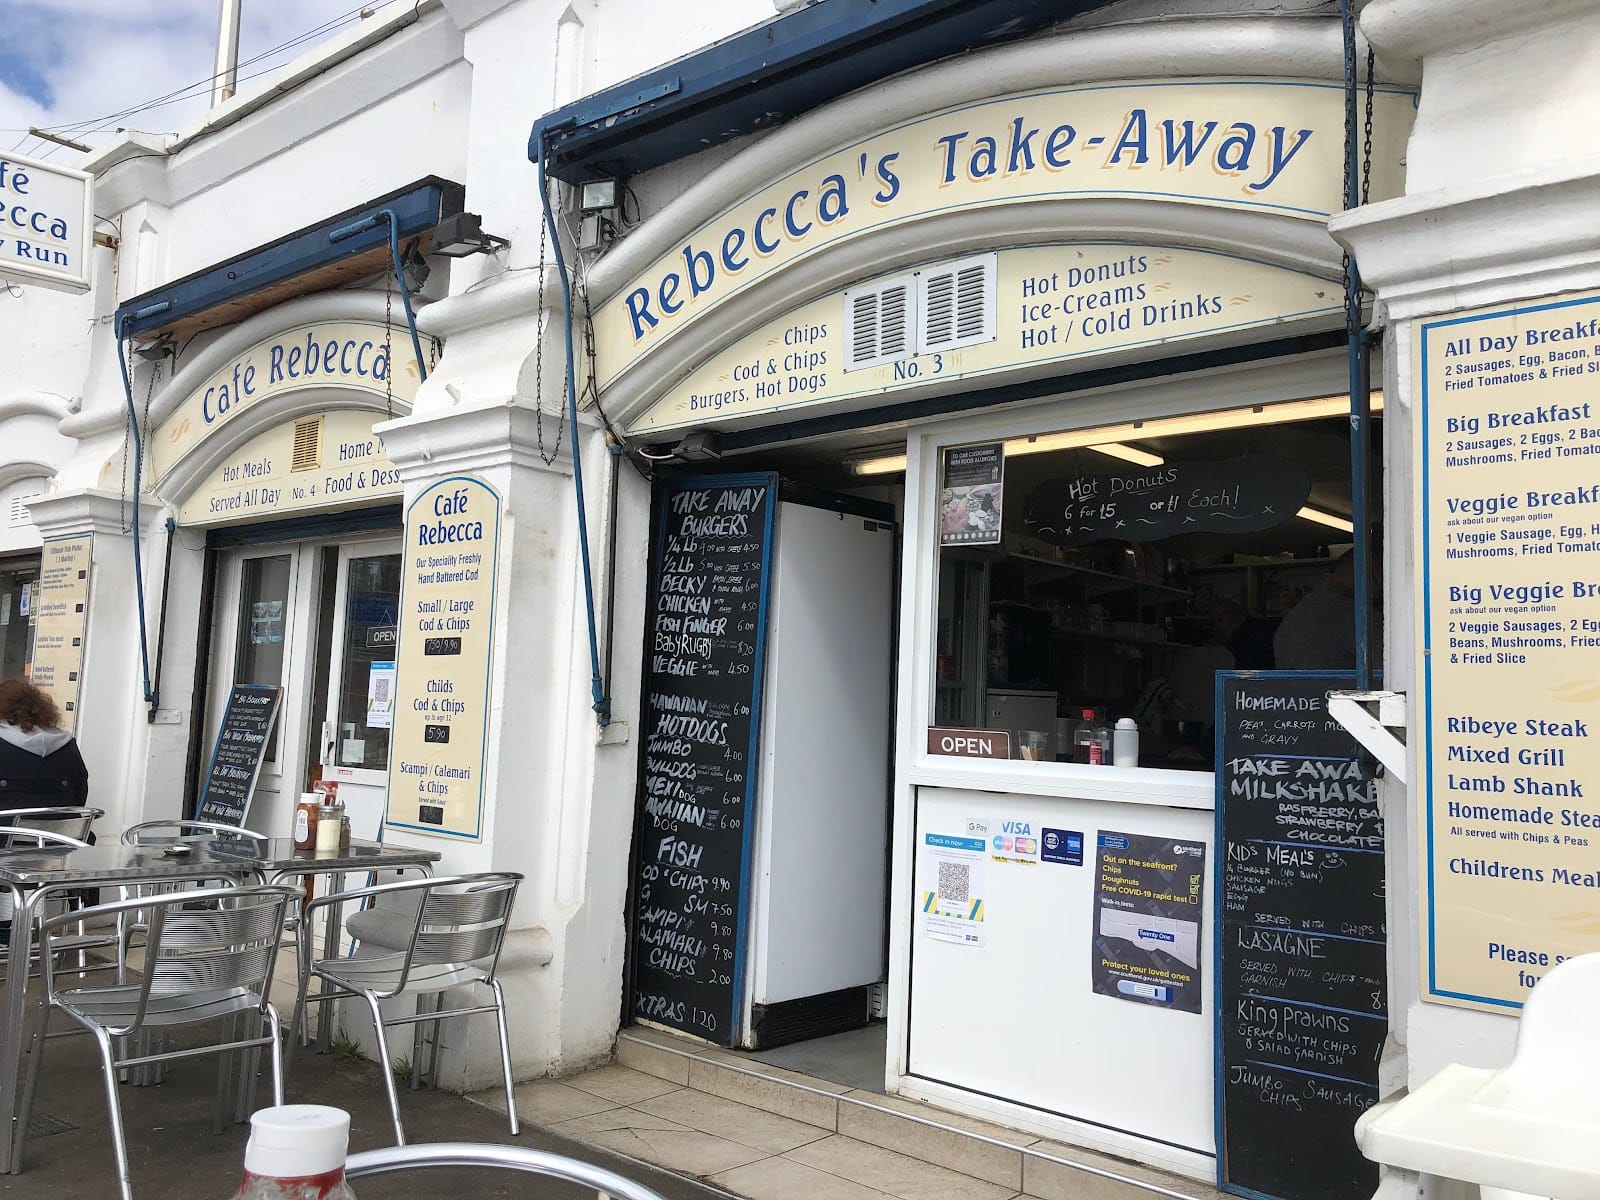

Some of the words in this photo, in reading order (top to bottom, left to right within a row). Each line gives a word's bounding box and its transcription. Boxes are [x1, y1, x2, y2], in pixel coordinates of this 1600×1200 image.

[933, 109, 1314, 192] Take-Away
[16, 240, 68, 266] Run
[624, 152, 900, 343] Rebecca's
[1022, 273, 1059, 298] Hot
[1068, 255, 1149, 289] Donuts
[1021, 281, 1147, 324] Ice-Creams
[1021, 326, 1058, 349] Hot
[1081, 308, 1131, 338] Cold
[1143, 294, 1223, 327] Drinks
[784, 324, 827, 346] Chips
[1445, 338, 1471, 358] All
[1479, 335, 1518, 353] Day
[733, 360, 760, 382] Cod
[784, 351, 827, 373] Chips
[893, 360, 923, 381] No.
[933, 354, 943, 374] 3
[1519, 355, 1544, 367] Egg,
[1549, 349, 1590, 362] Bacon,
[203, 357, 256, 424] Café
[269, 332, 390, 385] Rebecca
[756, 381, 782, 399] Hot
[789, 373, 827, 393] Dogs
[1445, 378, 1474, 391] Fried
[1478, 372, 1534, 387] Tomatoes
[1552, 364, 1583, 377] Fried
[1447, 416, 1480, 434] Big
[1488, 402, 1591, 429] Breakfast
[223, 466, 239, 482] Hot
[242, 458, 271, 479] Meals
[339, 441, 373, 461] Home
[1521, 448, 1551, 460] Fried
[210, 492, 241, 513] Served
[244, 489, 258, 507] All
[261, 488, 281, 506] Day
[292, 487, 306, 500] No.
[310, 485, 315, 497] 4
[325, 473, 353, 494] Food
[1069, 477, 1099, 501] Hot
[434, 488, 469, 516] Café
[672, 489, 712, 515] TAKE
[714, 487, 765, 513] AWAY
[1064, 504, 1073, 520] 6
[1150, 501, 1164, 511] or
[1187, 485, 1241, 510] Each!
[1447, 493, 1519, 515] Veggie
[680, 514, 748, 536] BURGERS
[1462, 517, 1484, 525] about
[1501, 514, 1525, 523] vegan
[1528, 512, 1553, 521] option
[419, 521, 483, 546] Rebecca
[1457, 531, 1496, 545] Veggie
[1560, 526, 1586, 538] Egg,
[1522, 543, 1553, 555] Fried
[416, 558, 426, 568] Our
[428, 555, 457, 569] Speciality
[458, 553, 482, 565] Freshly
[418, 572, 435, 584] Hand
[436, 570, 463, 583] Battered
[466, 569, 479, 581] Cod
[660, 574, 707, 594] BECKY
[1449, 584, 1482, 605] Big
[1489, 582, 1564, 603] Veggie
[418, 600, 441, 613] Small
[449, 600, 474, 614] Large
[658, 594, 710, 615] CHICKEN
[1450, 607, 1463, 615] ask
[1465, 606, 1486, 614] about
[419, 618, 434, 631] Cod
[447, 617, 470, 633] Chips
[655, 614, 680, 632] FISH
[683, 615, 727, 636] FINGER
[1459, 621, 1499, 634] Veggie
[373, 630, 396, 642] OPEN
[1450, 637, 1488, 649] Beans,
[1463, 652, 1492, 663] Fried
[1497, 652, 1526, 663] Slice
[427, 680, 453, 693] Childs
[414, 698, 429, 711] Cod
[441, 699, 465, 715] Chips
[1236, 691, 1320, 711] HOMEMADE
[1448, 716, 1518, 738] Ribeye
[1525, 719, 1588, 737] Steak
[941, 736, 992, 754] OPEN
[1261, 734, 1299, 745] GRAVY
[1448, 745, 1510, 764] Mixed
[1518, 748, 1565, 767] Grill
[400, 762, 428, 777] Scampi
[435, 765, 471, 779] Calamari
[1225, 758, 1291, 776] TAKE
[427, 781, 448, 796] Chips
[1448, 774, 1505, 793] Lamb
[1513, 777, 1584, 798] Shank
[1448, 801, 1554, 825] Homemade
[654, 816, 678, 832] DOG
[976, 824, 988, 832] Pay
[1002, 822, 1031, 835] VISA
[1275, 815, 1363, 833] STRAWBERRY
[929, 836, 943, 844] Check
[1287, 830, 1384, 848] CHOCOLATE
[1451, 827, 1463, 836] All
[1465, 829, 1497, 839] served
[1500, 830, 1520, 841] with
[1522, 832, 1550, 844] Chips
[1564, 835, 1589, 846] Peas
[657, 835, 704, 868] FISH
[1103, 855, 1117, 864] Out
[1129, 858, 1140, 867] the
[1142, 861, 1178, 871] seafront?
[1103, 865, 1121, 874] Chips
[1449, 858, 1544, 882] Childrens
[670, 871, 709, 894] CHIPS
[1102, 874, 1140, 886] Doughnuts
[1102, 884, 1117, 893] Free
[1118, 886, 1152, 898] COVID-19
[1153, 892, 1171, 901] rapid
[1173, 894, 1188, 903] test
[1226, 902, 1245, 911] HAM
[1139, 930, 1158, 939] Twenty
[1254, 913, 1291, 925] SERVED
[1302, 920, 1324, 928] WITH
[1341, 922, 1375, 936] CHIPS
[1238, 928, 1327, 958] LASAGNE
[650, 948, 696, 976] CHIPS
[1488, 942, 1549, 966] Please
[1102, 959, 1128, 970] Protect
[1129, 964, 1147, 975] your
[1149, 967, 1169, 978] loved
[1171, 972, 1190, 982] ones
[1240, 959, 1277, 974] SERVED
[1288, 967, 1312, 978] WITH
[1241, 973, 1288, 989] GARNISH
[1238, 1000, 1278, 1032] King
[1238, 1024, 1284, 1040] SERVED
[1288, 1033, 1317, 1048] WITH
[1258, 1040, 1291, 1055] SALAD
[1231, 1066, 1283, 1090] JUMBO
[1260, 1090, 1303, 1111] CHIPS
